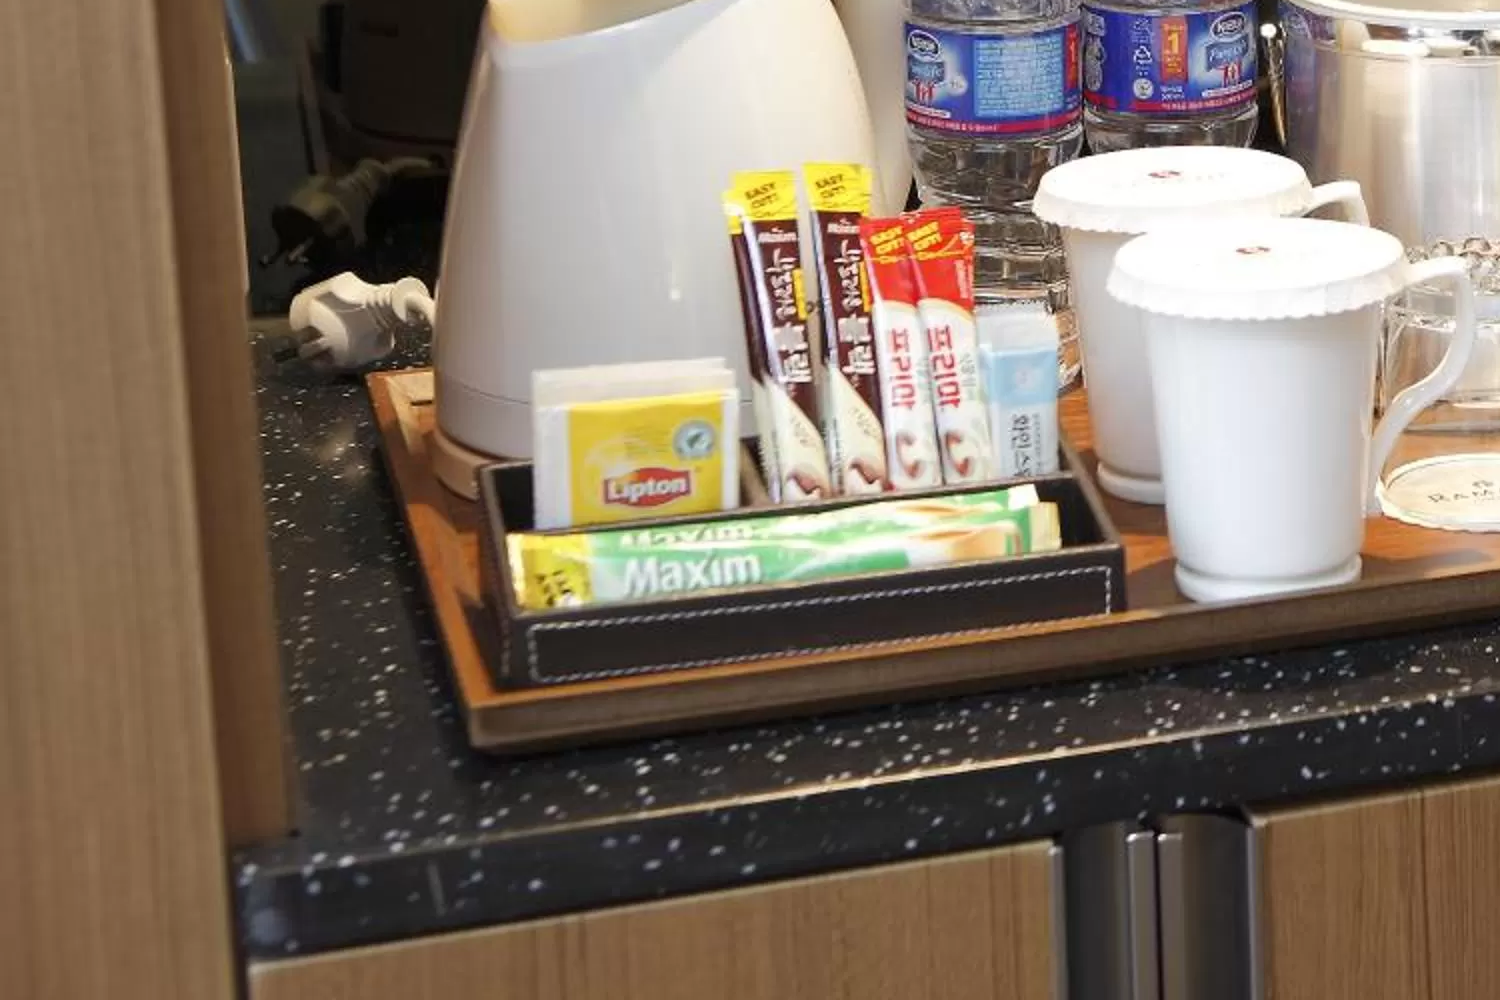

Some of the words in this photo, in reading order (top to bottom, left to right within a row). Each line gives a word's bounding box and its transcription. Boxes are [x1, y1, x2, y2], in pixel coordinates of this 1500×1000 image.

[744, 182, 776, 201] EASY
[606, 476, 688, 504] Lipton
[624, 549, 761, 600] Maxim
